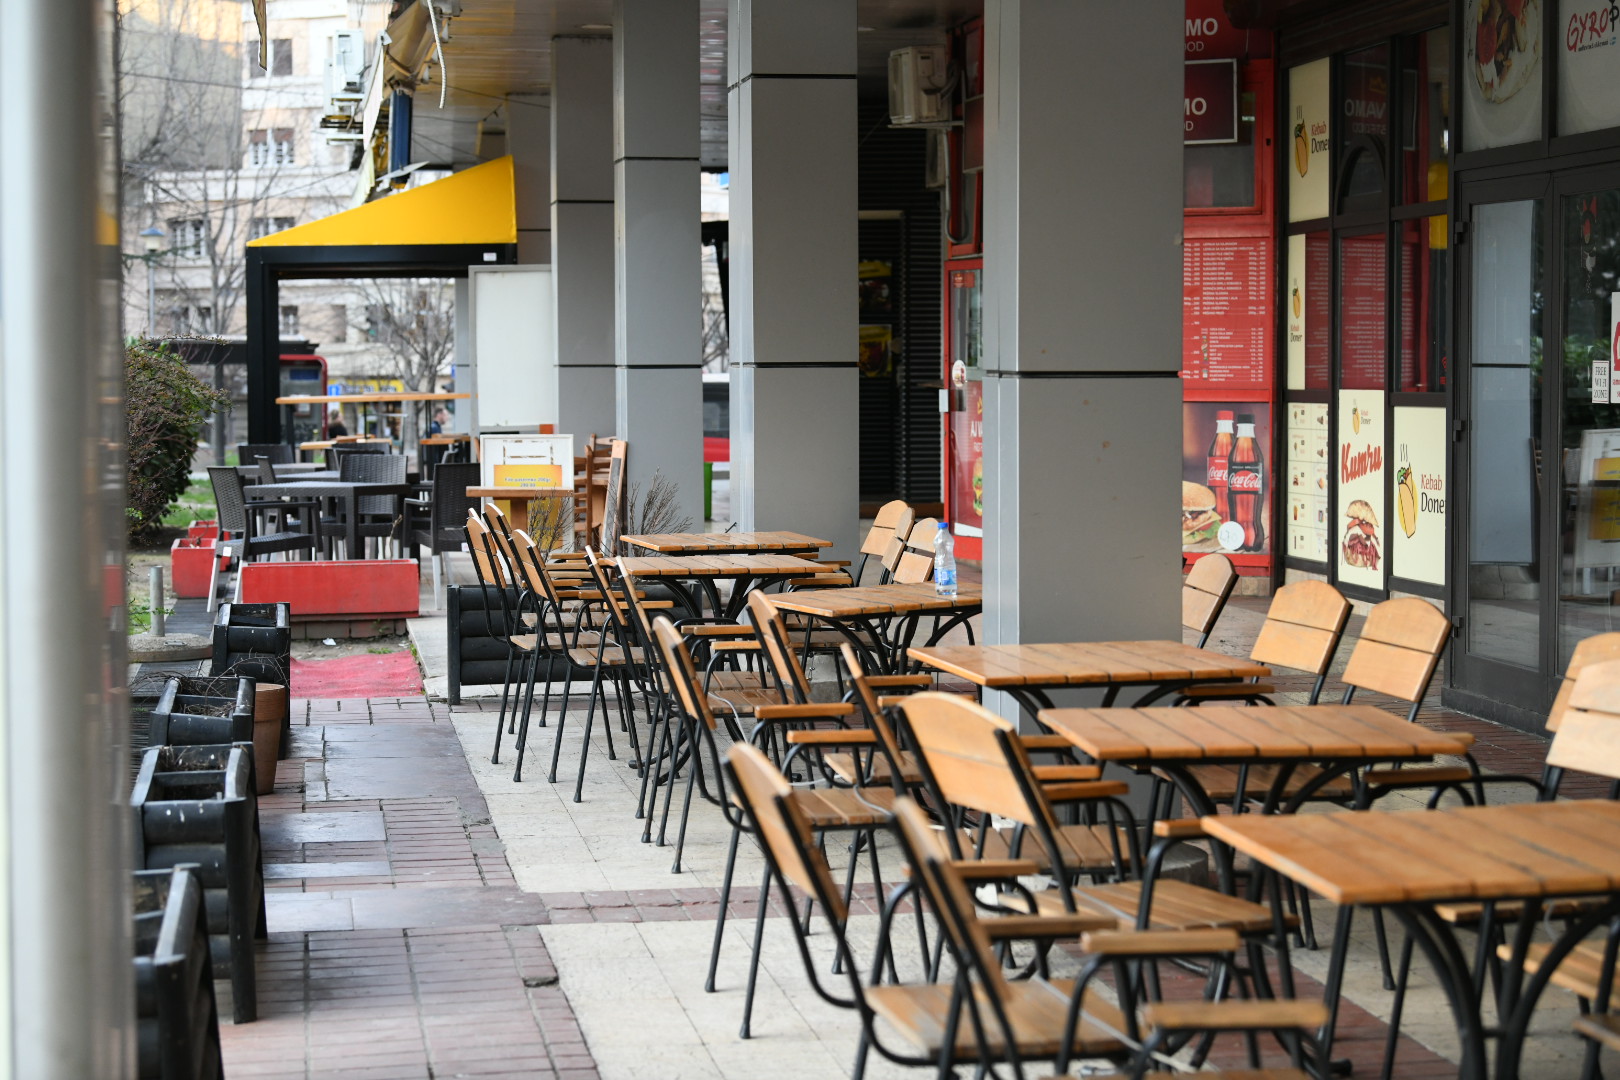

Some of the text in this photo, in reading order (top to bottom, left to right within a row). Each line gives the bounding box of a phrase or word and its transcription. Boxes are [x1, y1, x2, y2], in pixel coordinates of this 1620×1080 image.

[1186, 18, 1218, 36] MO
[1184, 41, 1204, 52] OD
[1595, 366, 1606, 375] FREE
[1341, 442, 1382, 485] Kumru
[1229, 472, 1262, 488] Coca-Cola
[1421, 474, 1442, 490] Kebab
[1421, 492, 1445, 513] Done
